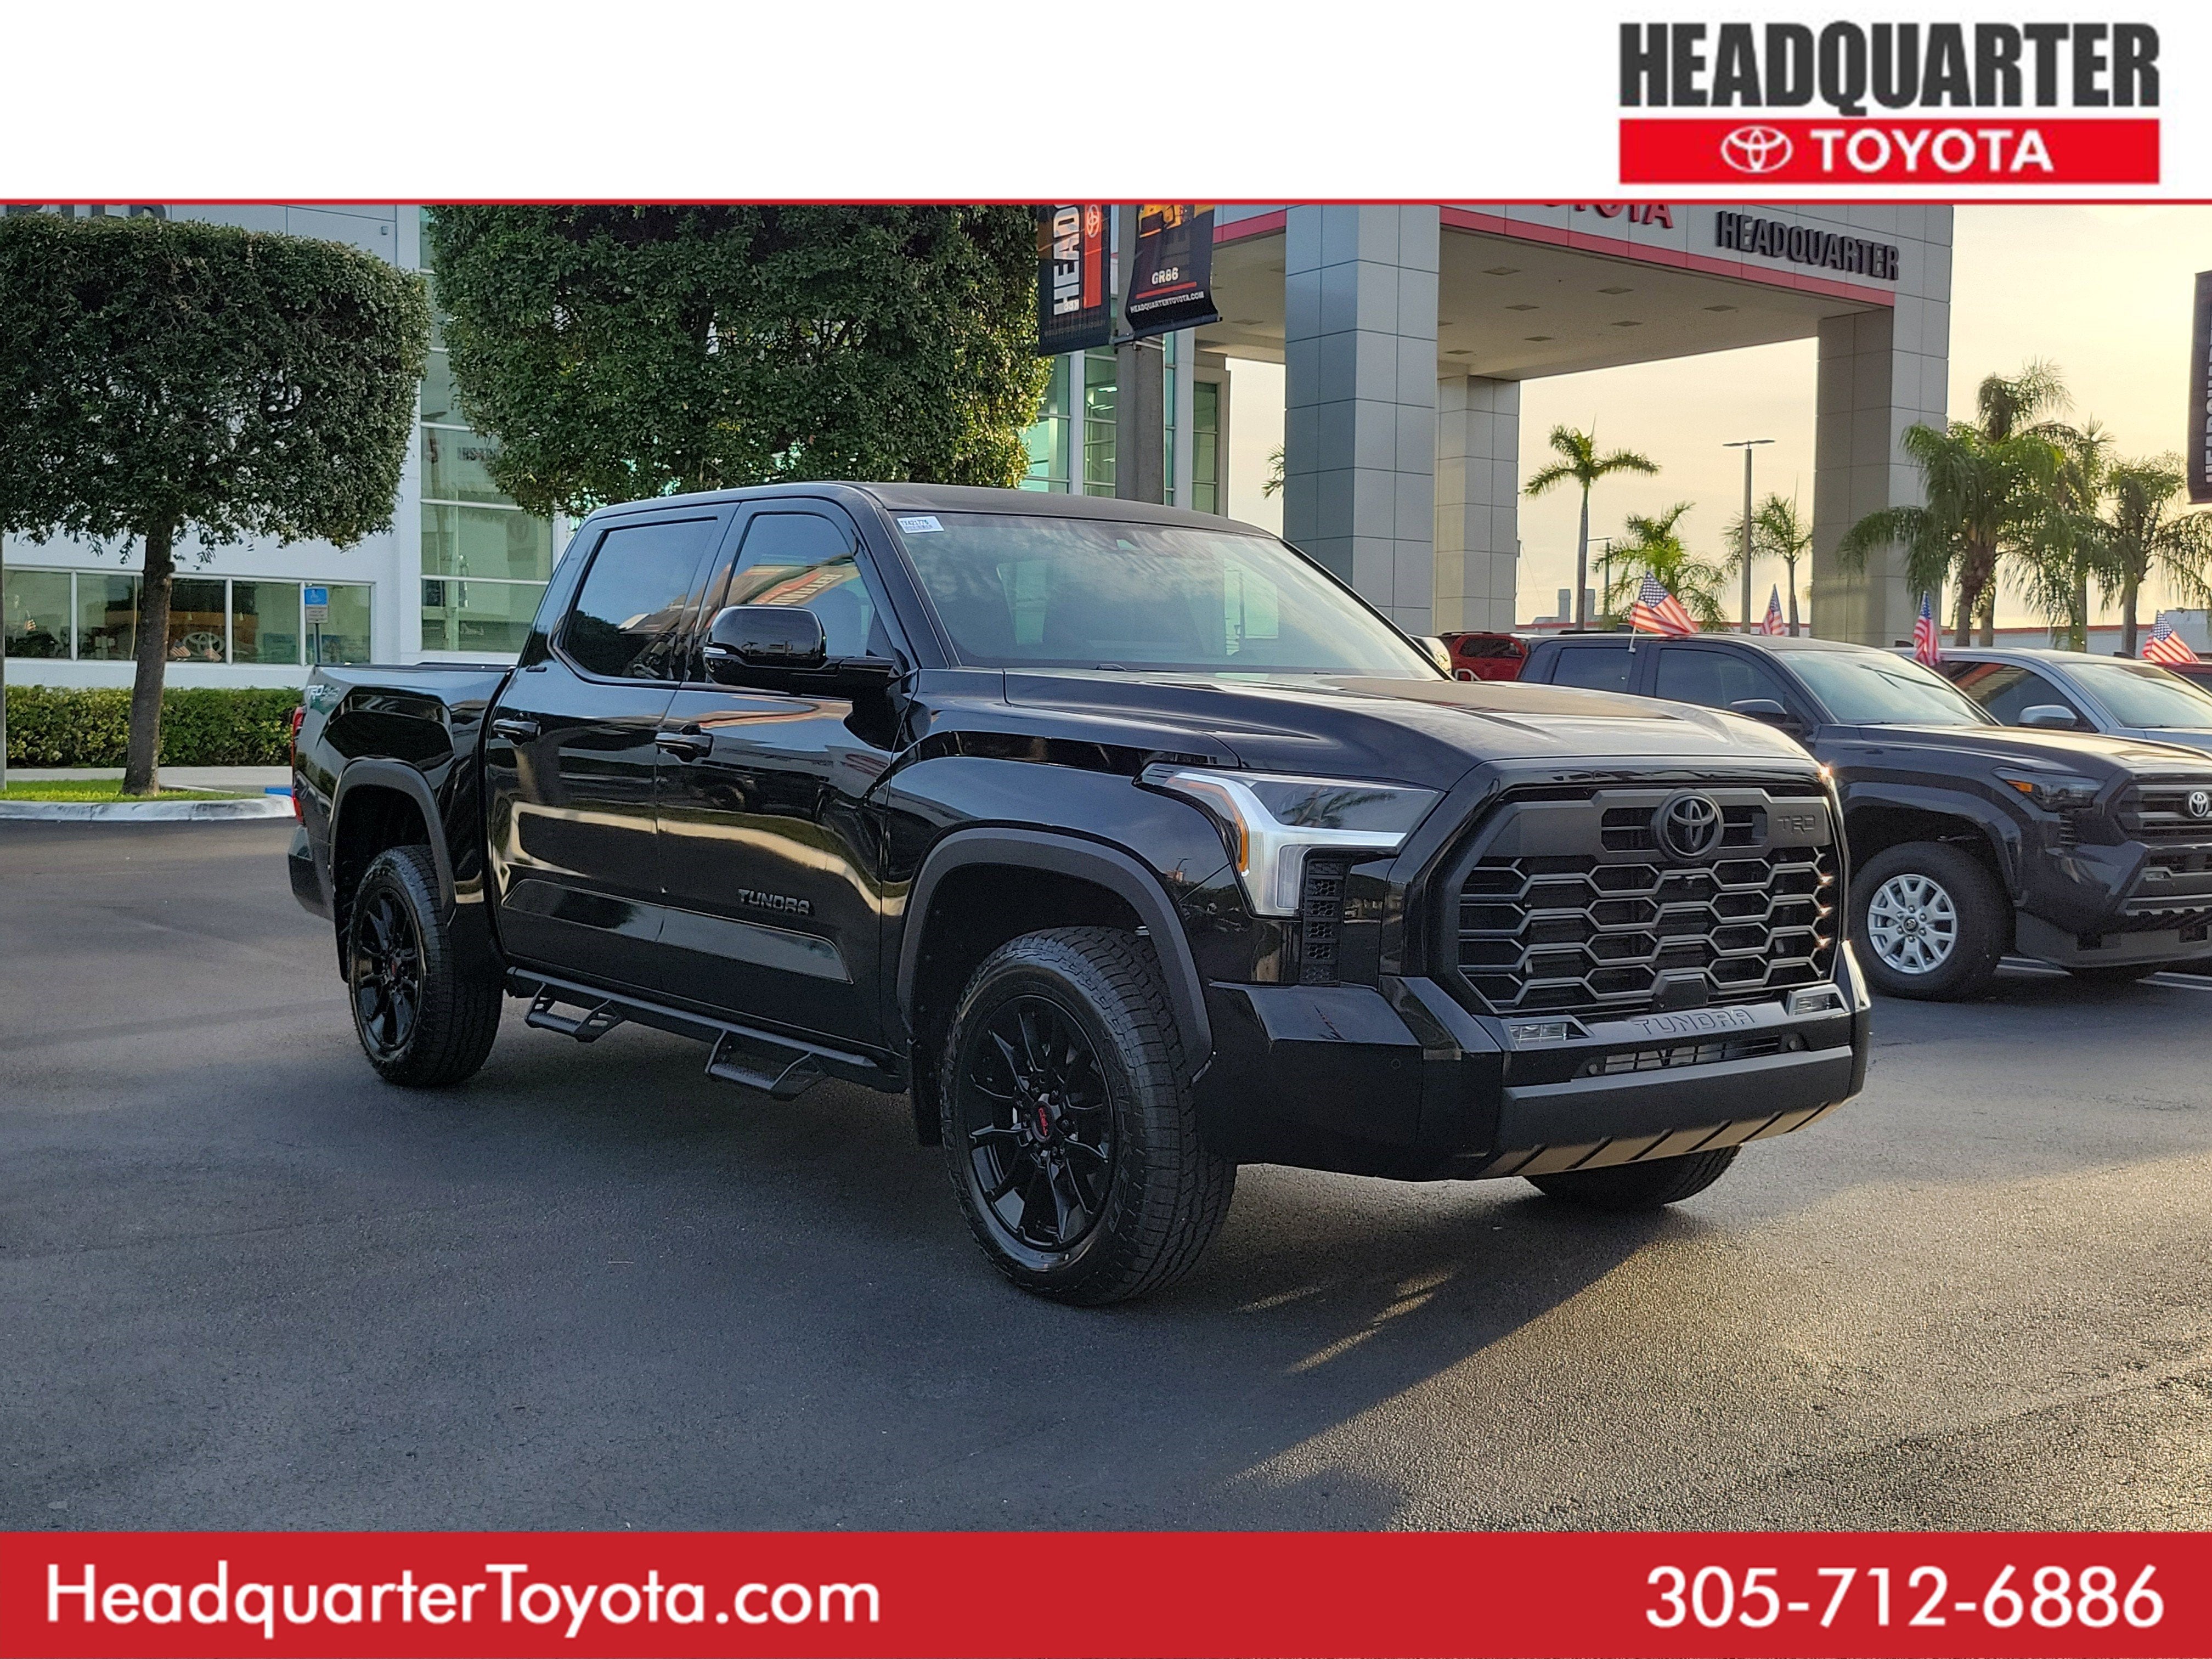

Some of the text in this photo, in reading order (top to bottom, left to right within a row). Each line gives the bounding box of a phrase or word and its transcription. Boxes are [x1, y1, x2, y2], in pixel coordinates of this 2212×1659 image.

[1716, 211, 1899, 280] HEADQUARTER
[1053, 205, 1080, 315] HEAD
[1152, 267, 1179, 285] GR86
[1130, 291, 1205, 313] HEADQUARTERTOYOTA.COM
[1778, 815, 1815, 834] TRD
[738, 888, 810, 915] TUNDRA
[1630, 1008, 1755, 1035] TUNDRA
